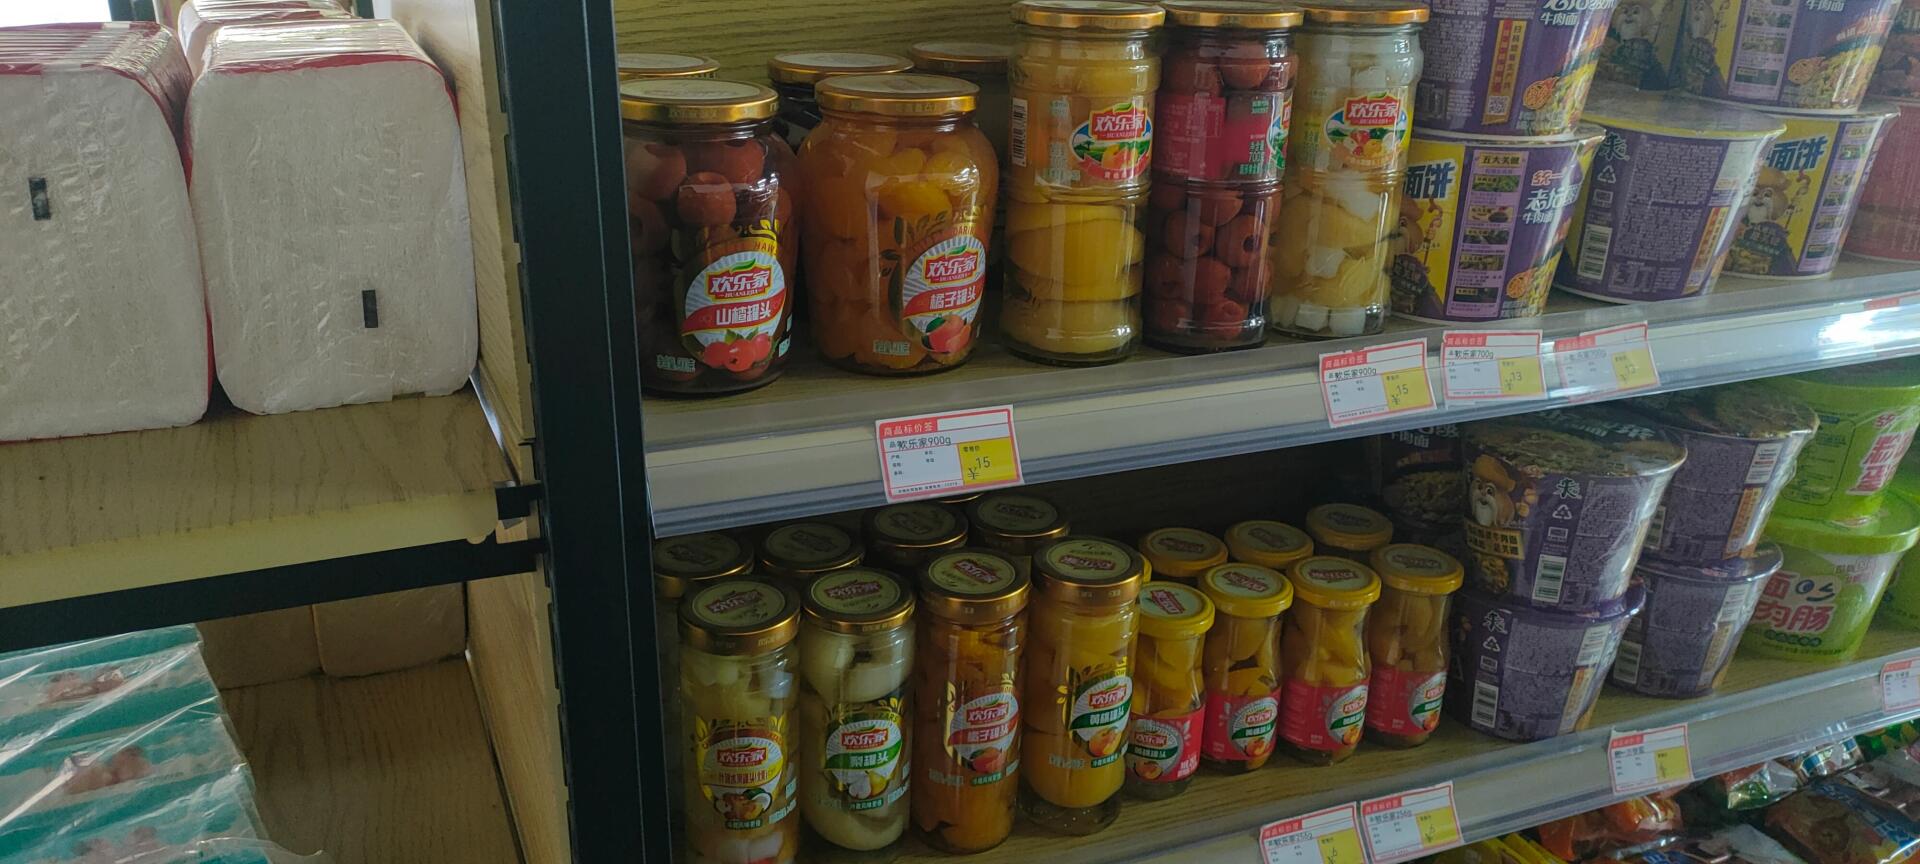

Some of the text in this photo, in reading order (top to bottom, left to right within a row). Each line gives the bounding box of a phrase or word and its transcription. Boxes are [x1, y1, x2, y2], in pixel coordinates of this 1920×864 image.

[1348, 101, 1398, 118] 欢乐家
[1093, 113, 1145, 132] 欢乐家
[926, 254, 977, 278] 欢乐家
[710, 270, 770, 293] 欢乐家
[930, 285, 977, 310] 橘子罐头
[716, 300, 771, 326] 山楂罐头
[883, 421, 934, 437] 商品标价签
[842, 729, 887, 746] 欢乐家
[718, 749, 766, 764] 欢乐家
